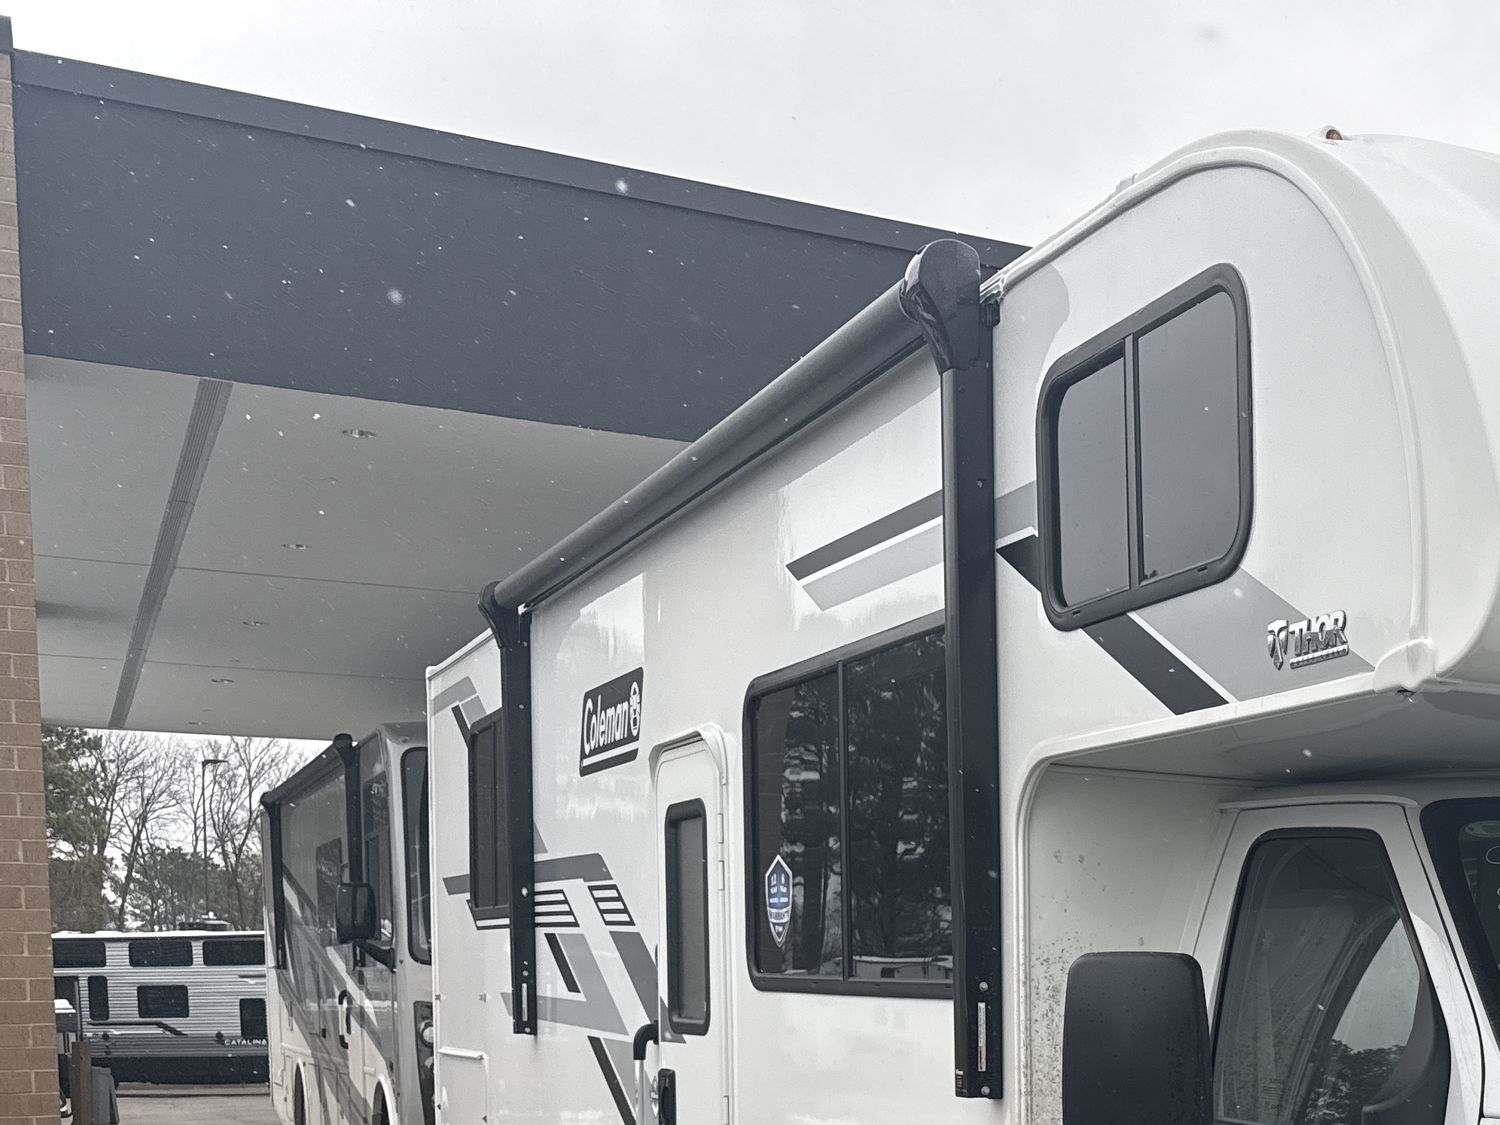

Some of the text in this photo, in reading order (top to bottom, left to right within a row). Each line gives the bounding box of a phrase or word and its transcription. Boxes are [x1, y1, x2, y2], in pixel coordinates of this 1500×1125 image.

[1289, 610, 1348, 657] THOR
[583, 694, 629, 756] Coleman
[223, 1038, 268, 1046] CATALINA
